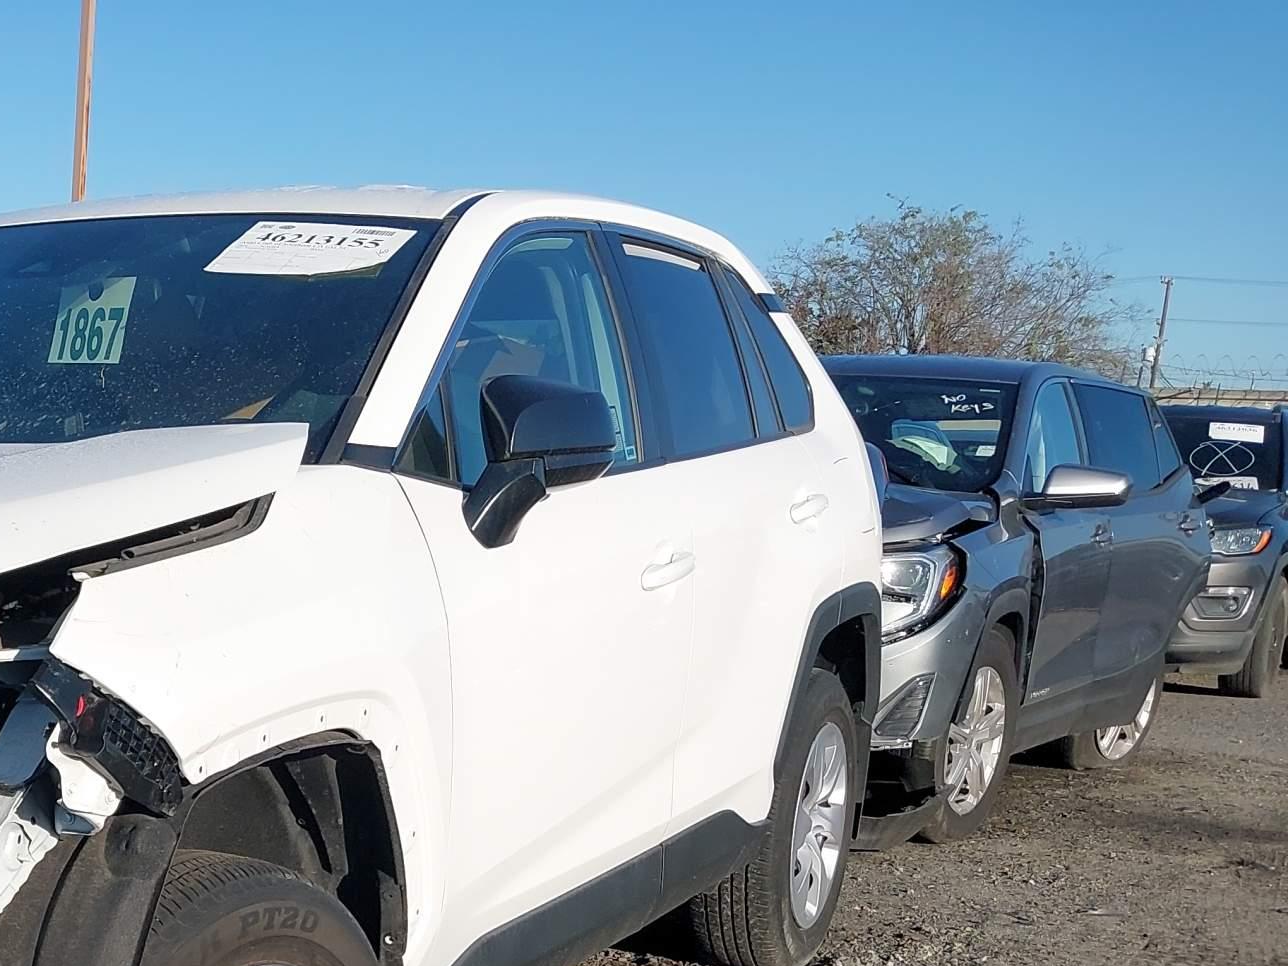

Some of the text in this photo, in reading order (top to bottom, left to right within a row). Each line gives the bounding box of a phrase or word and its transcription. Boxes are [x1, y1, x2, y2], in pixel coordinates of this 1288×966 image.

[256, 232, 385, 249] 46213155
[57, 307, 125, 361] 1867
[940, 394, 966, 404] NO
[238, 906, 320, 941] PT20
